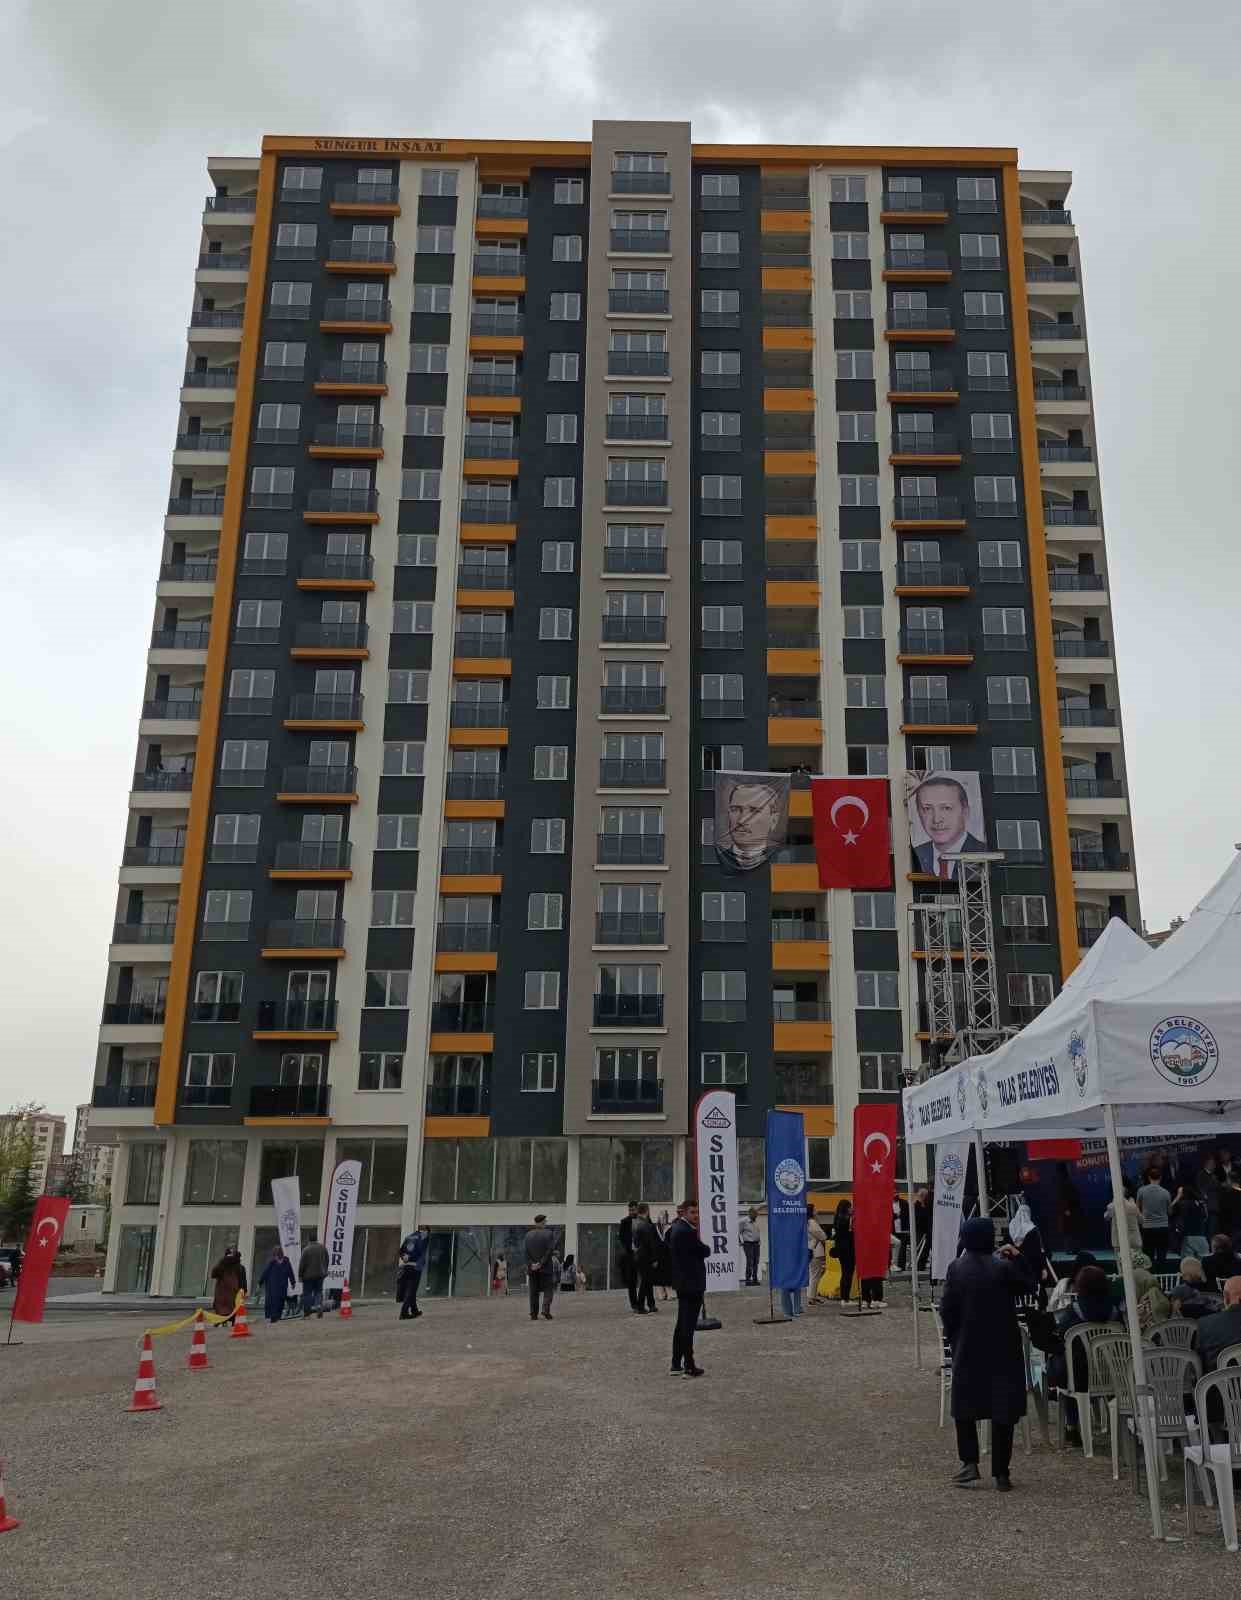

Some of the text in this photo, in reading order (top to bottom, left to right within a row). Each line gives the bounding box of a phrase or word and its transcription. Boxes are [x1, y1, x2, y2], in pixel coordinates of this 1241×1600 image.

[313, 138, 377, 151] SUNGUR
[1153, 1028, 1164, 1060] TALAS
[997, 1075, 1017, 1107] TALAS
[1018, 1057, 1060, 1101] BELEDİYESİ
[1178, 1075, 1199, 1085] 1907
[918, 1102, 931, 1127] TALAS
[709, 1134, 729, 1254] SUNGUR
[331, 1188, 349, 1266] SUNGUR
